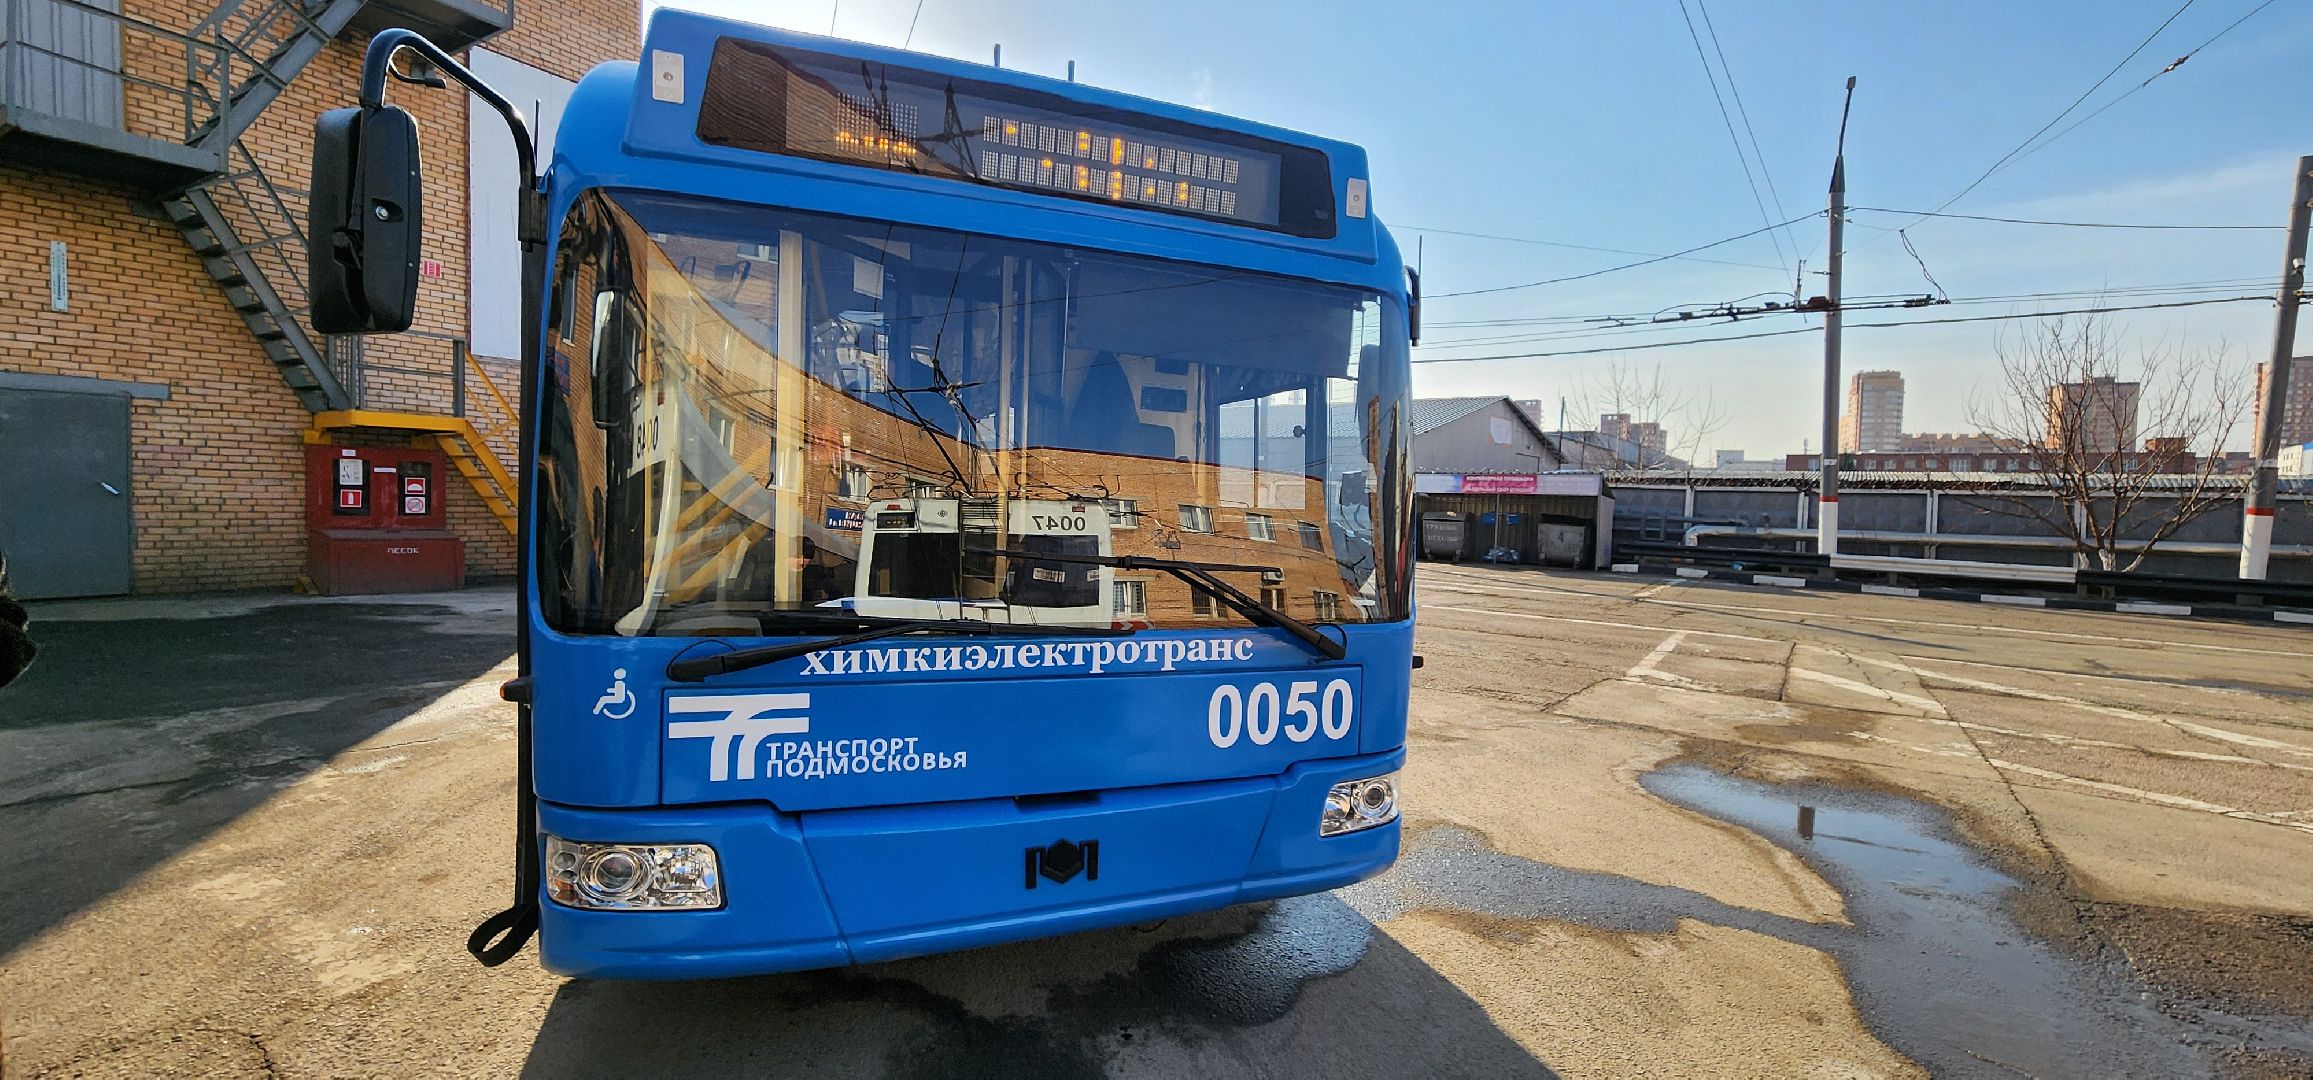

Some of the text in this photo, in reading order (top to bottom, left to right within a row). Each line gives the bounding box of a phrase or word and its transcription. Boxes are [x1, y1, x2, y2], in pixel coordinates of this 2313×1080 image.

[800, 638, 1254, 675] химкиэлектротранс
[1208, 678, 1354, 749] 0050
[766, 737, 919, 761] ТРАНСПОРТ
[766, 751, 968, 779] ПОДМОСКОВЬЯ
